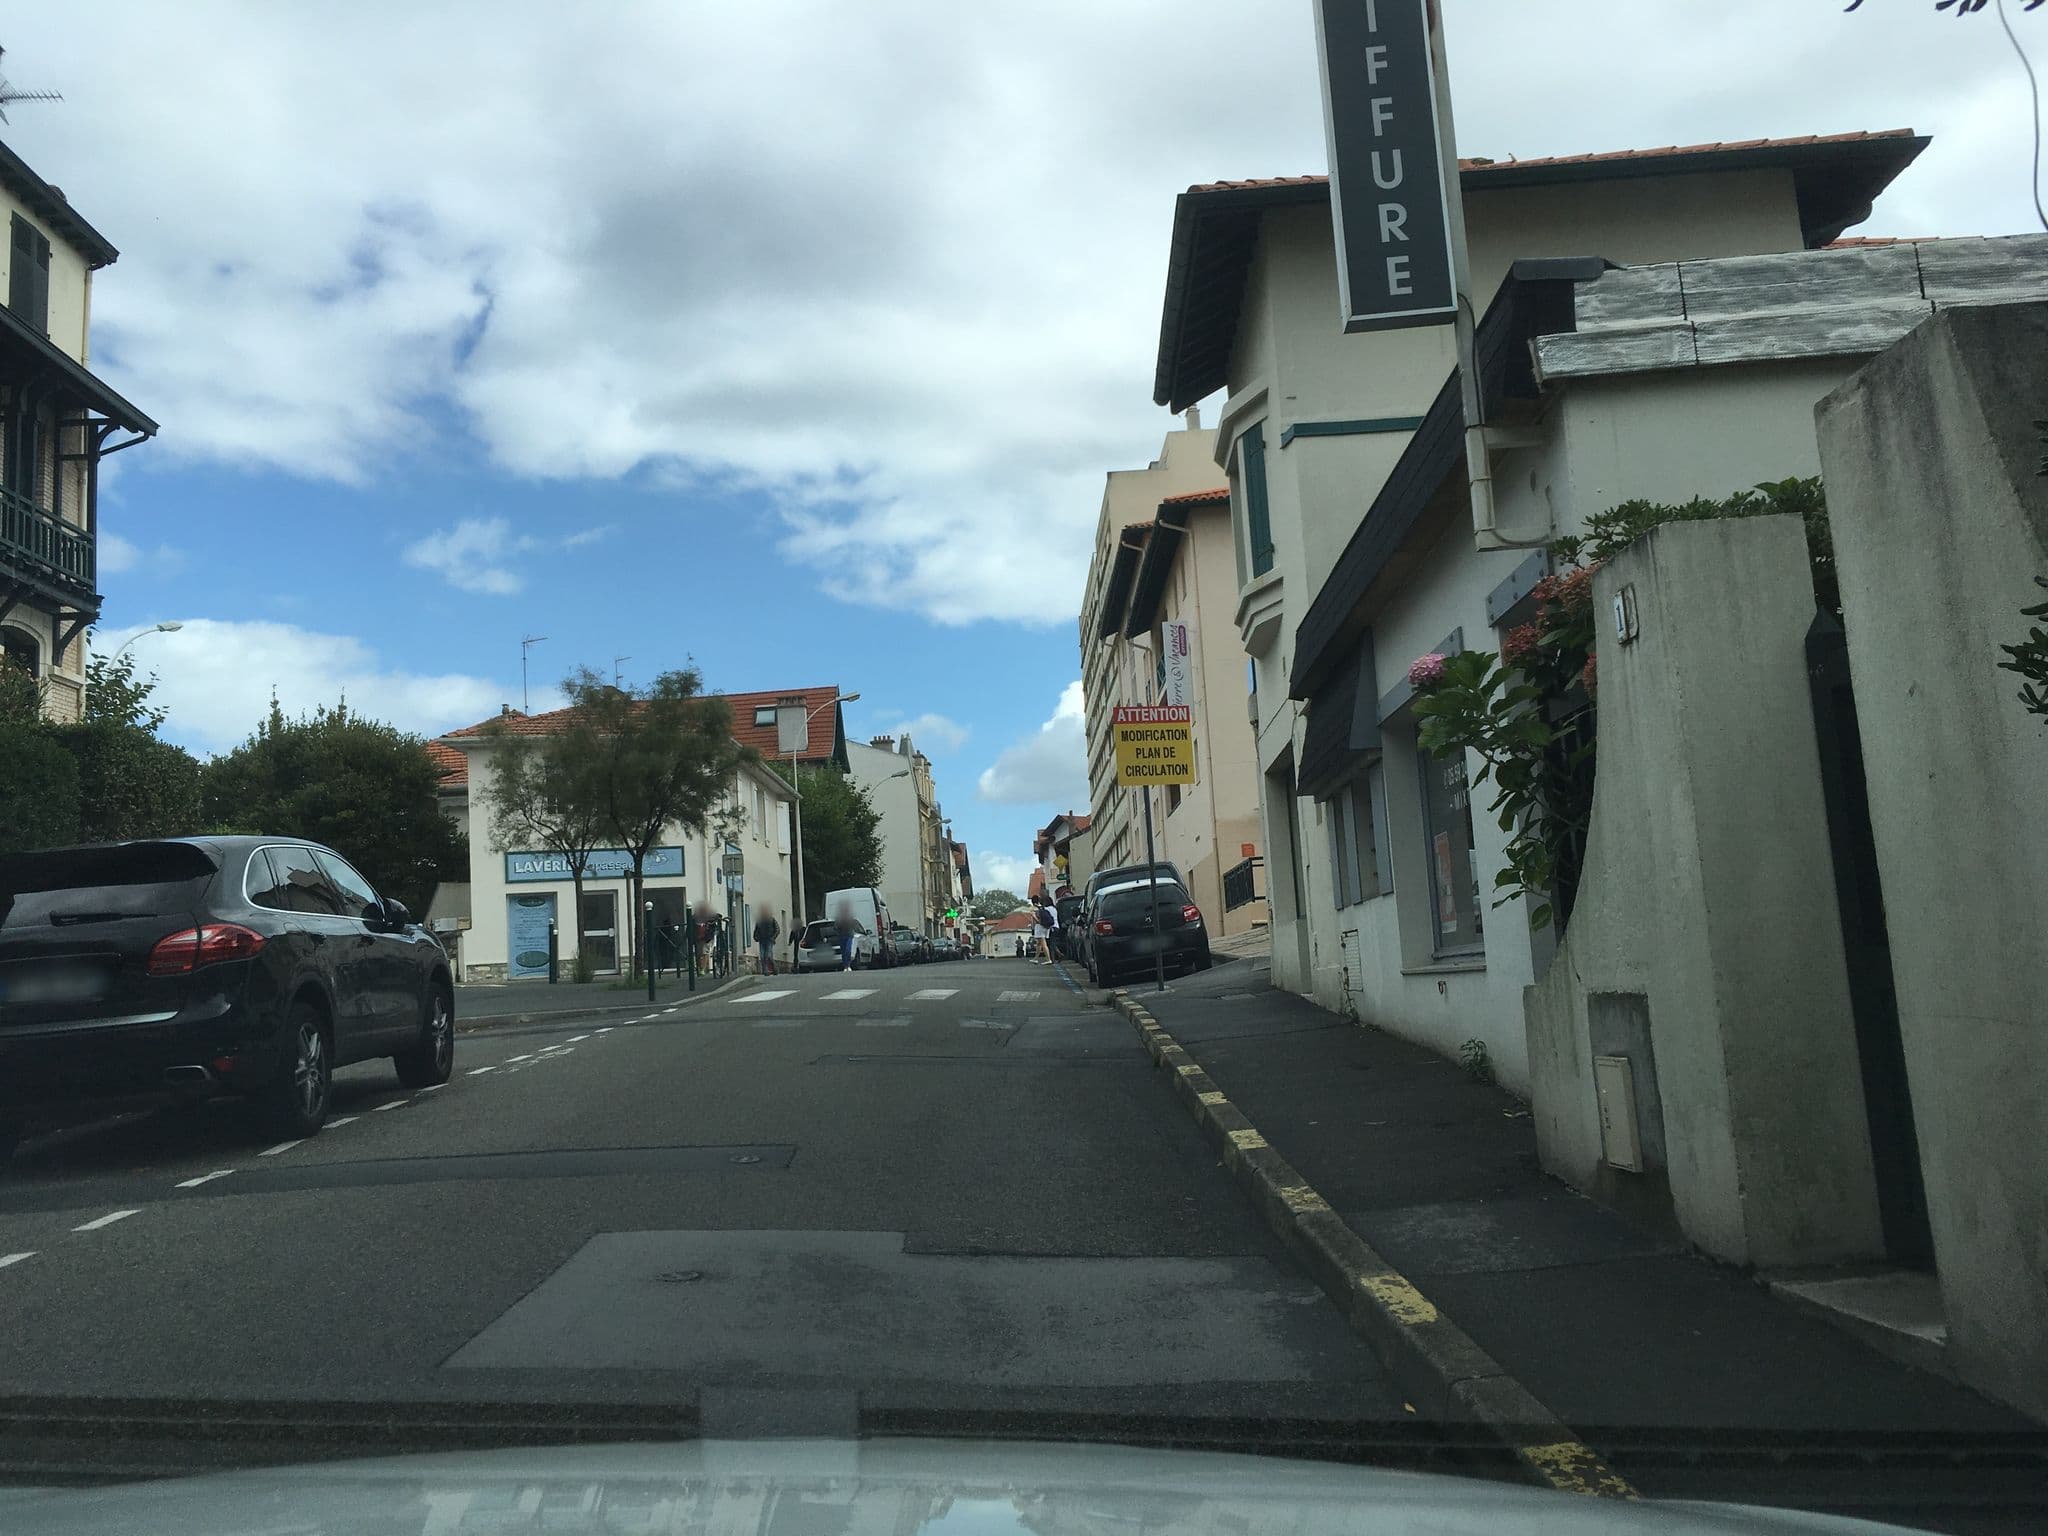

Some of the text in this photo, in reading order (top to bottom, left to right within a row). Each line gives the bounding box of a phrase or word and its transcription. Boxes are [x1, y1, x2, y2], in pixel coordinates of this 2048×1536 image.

[1364, 0, 1413, 296] IFFURE
[1169, 624, 1181, 666] Vacances
[1117, 707, 1188, 722] ATTENTION
[1120, 729, 1188, 742] MODIFICATION
[1135, 746, 1176, 759] PLAN DE
[1125, 763, 1189, 777] CIRCULATION
